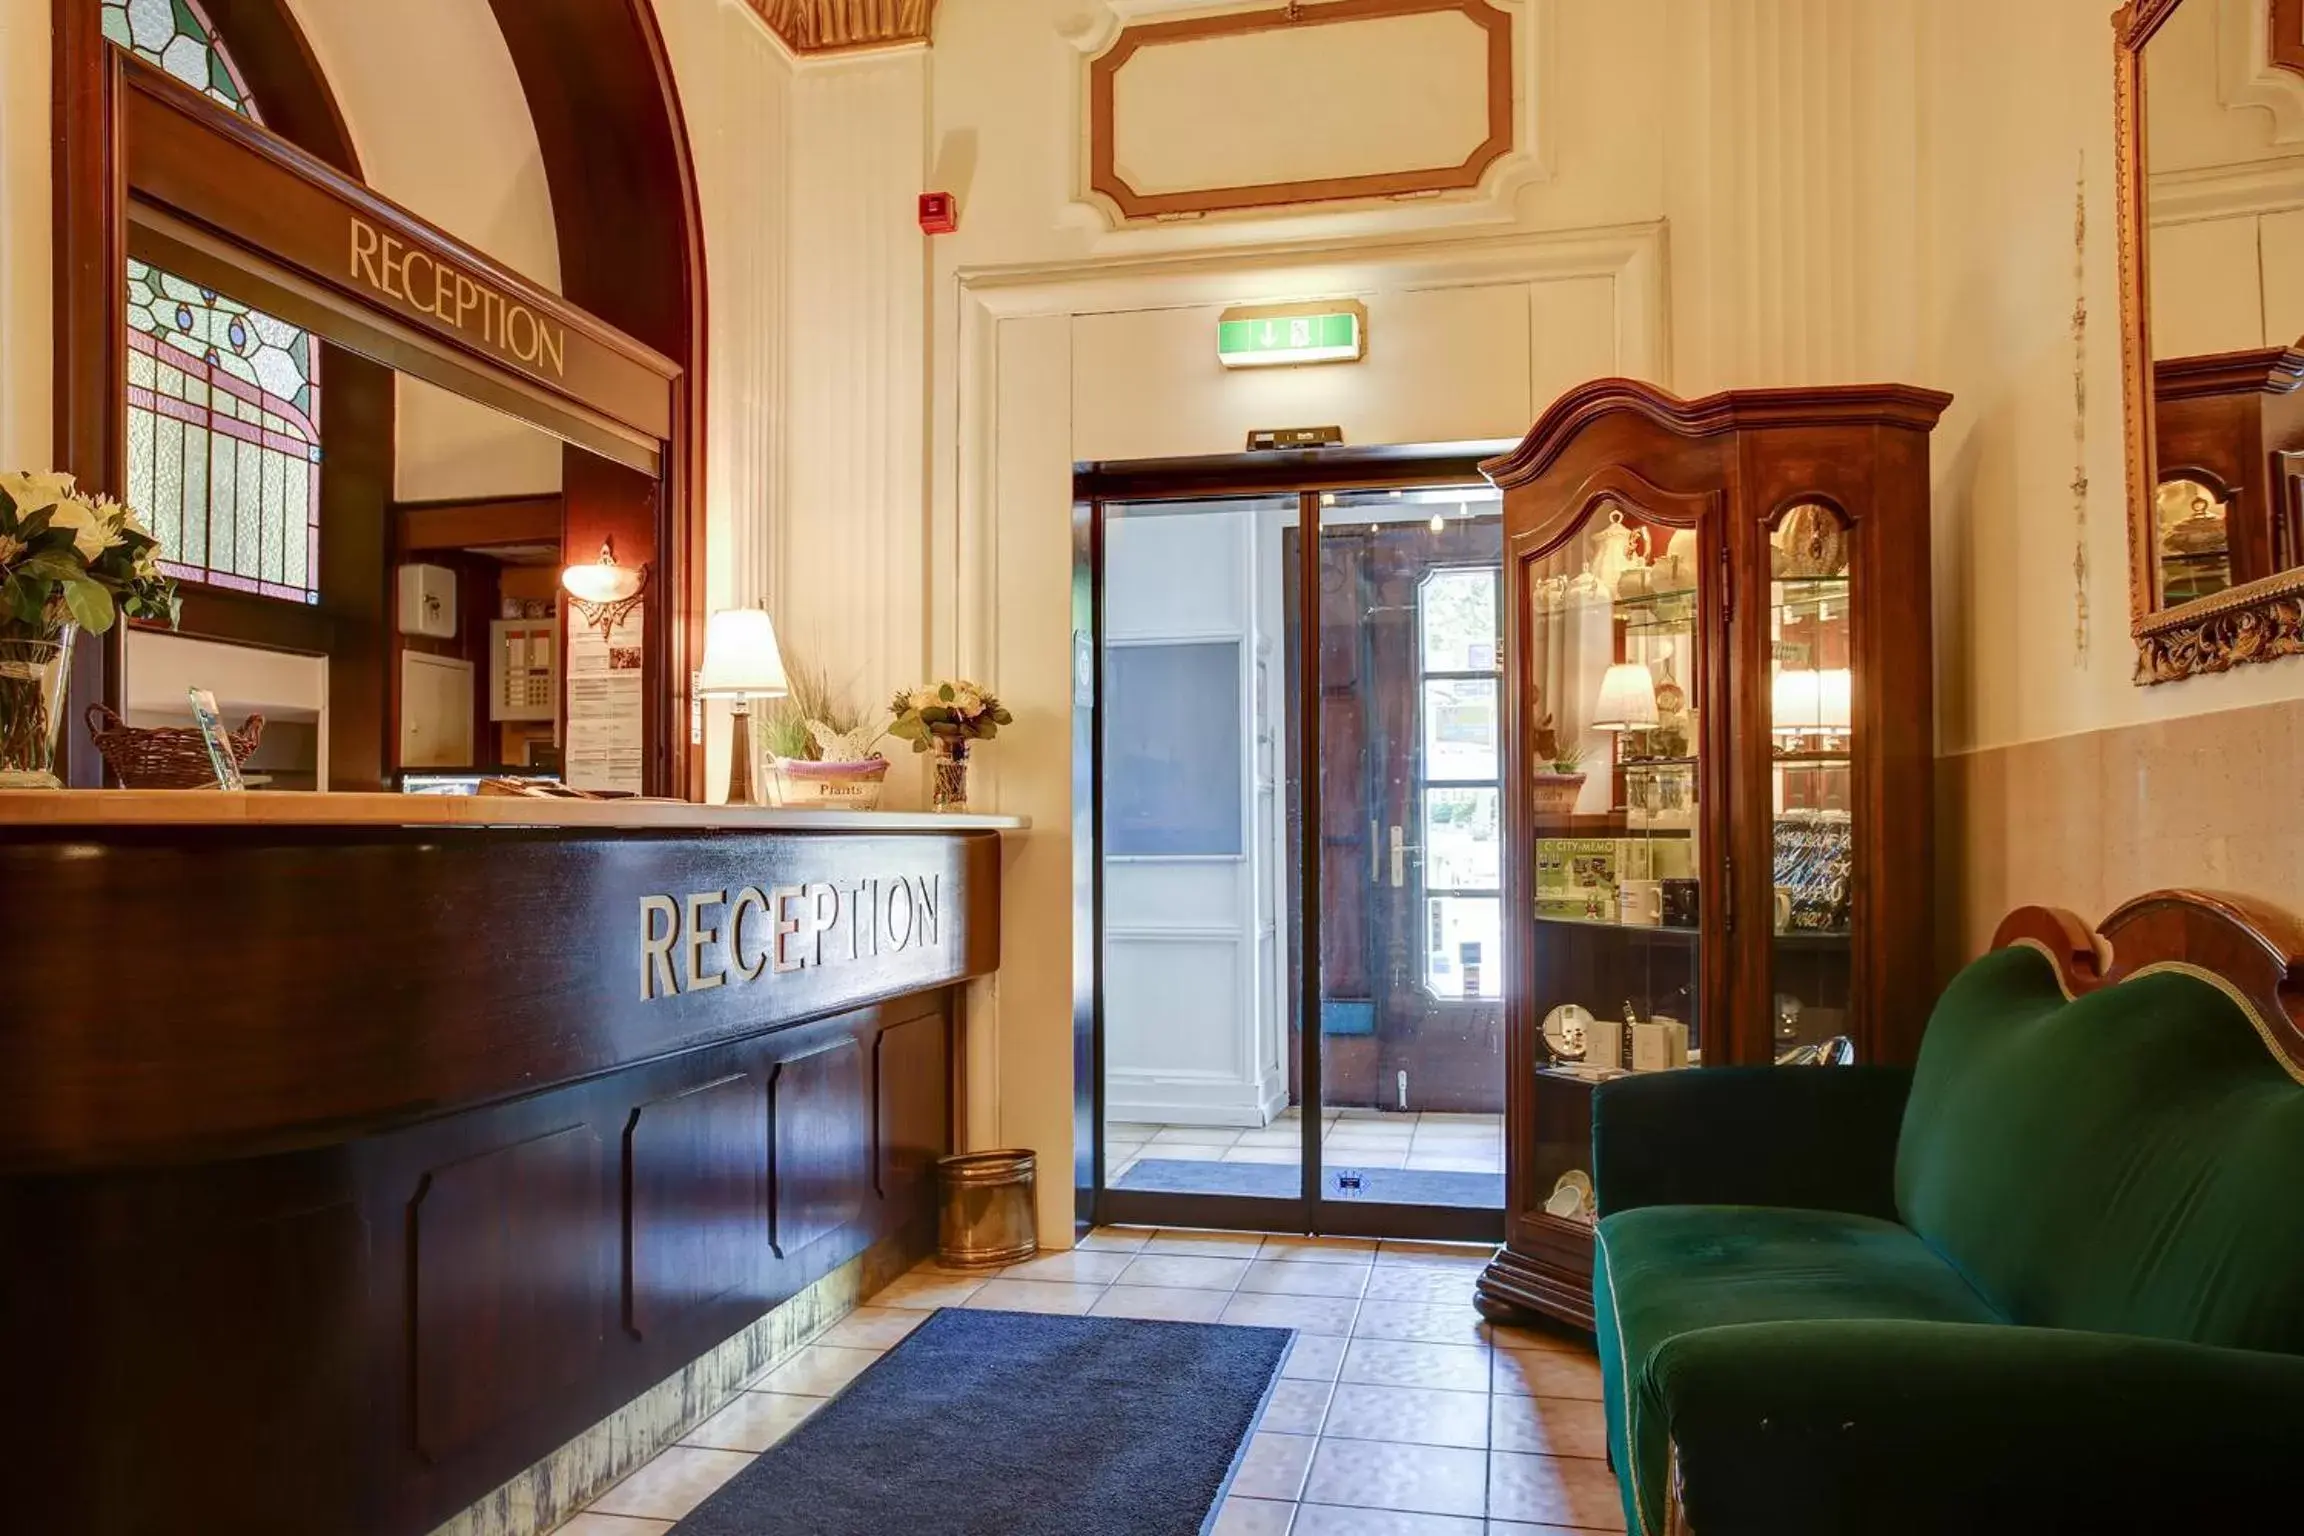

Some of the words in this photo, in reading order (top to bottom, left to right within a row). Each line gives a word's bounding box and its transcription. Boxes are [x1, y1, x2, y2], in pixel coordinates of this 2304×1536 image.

[350, 216, 564, 378] RECEPTION
[820, 784, 863, 795] Plants
[639, 873, 940, 1002] RECEPTION
